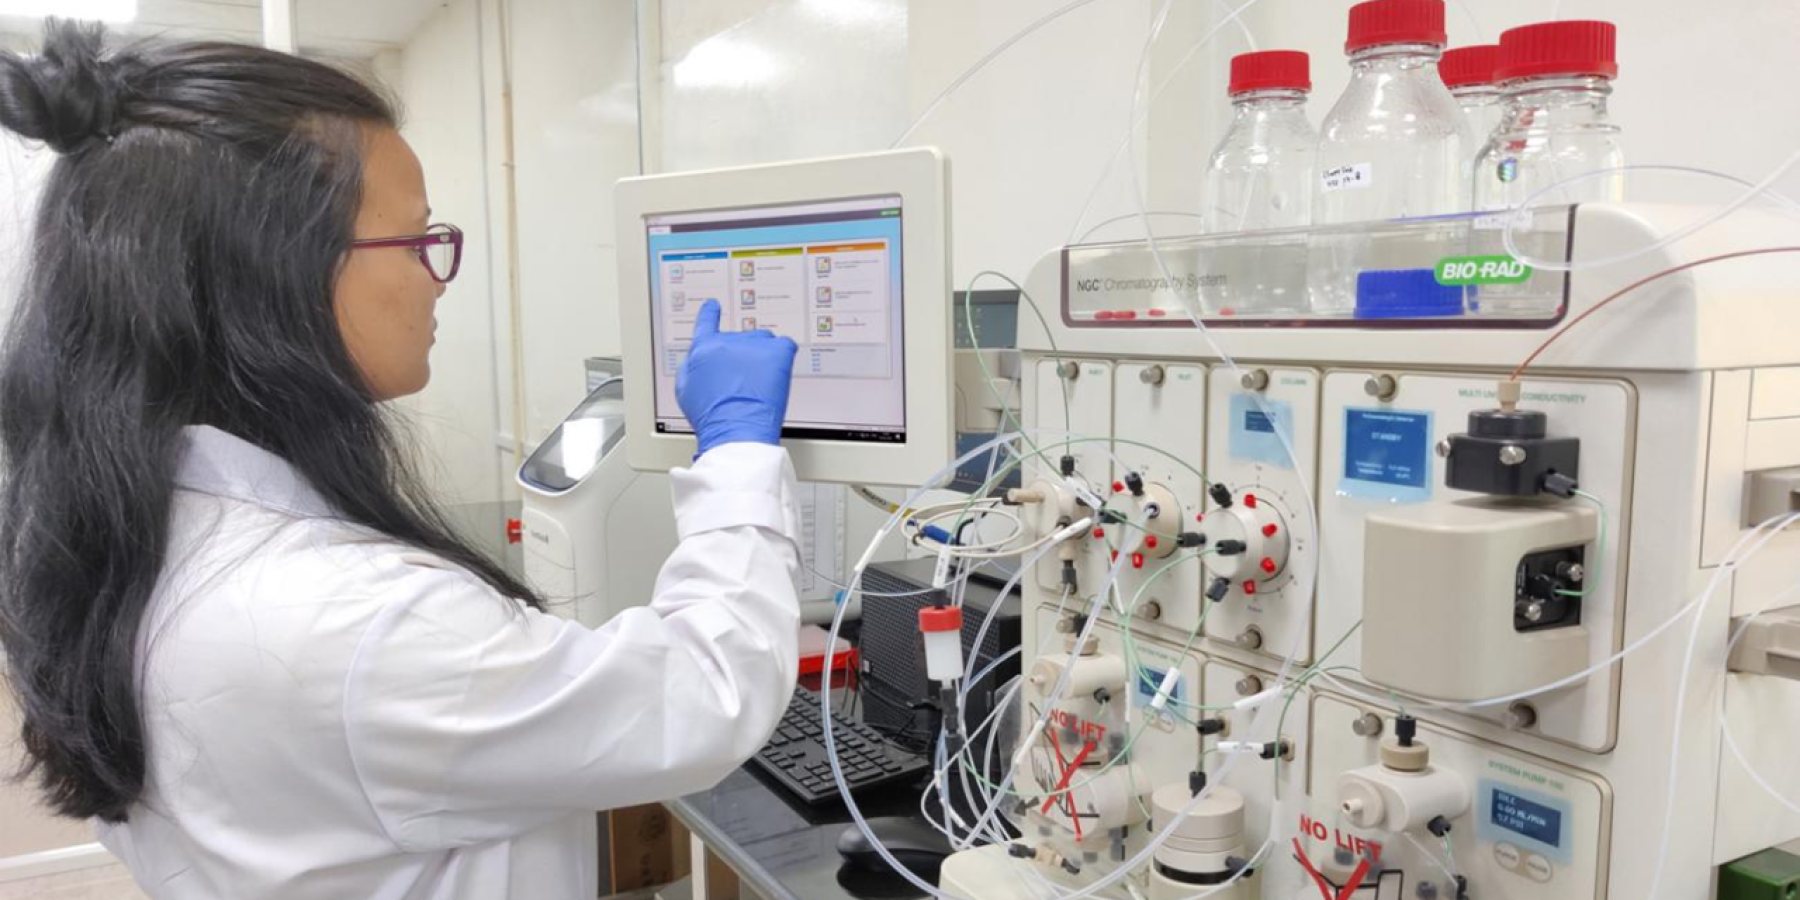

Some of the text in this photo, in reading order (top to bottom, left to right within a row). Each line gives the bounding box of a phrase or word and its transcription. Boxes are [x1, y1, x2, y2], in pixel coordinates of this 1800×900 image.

[1443, 261, 1524, 278] BIO-RAD
[1187, 273, 1227, 290] System
[1050, 709, 1068, 727] NO
[1300, 813, 1382, 863] NO LIFT
